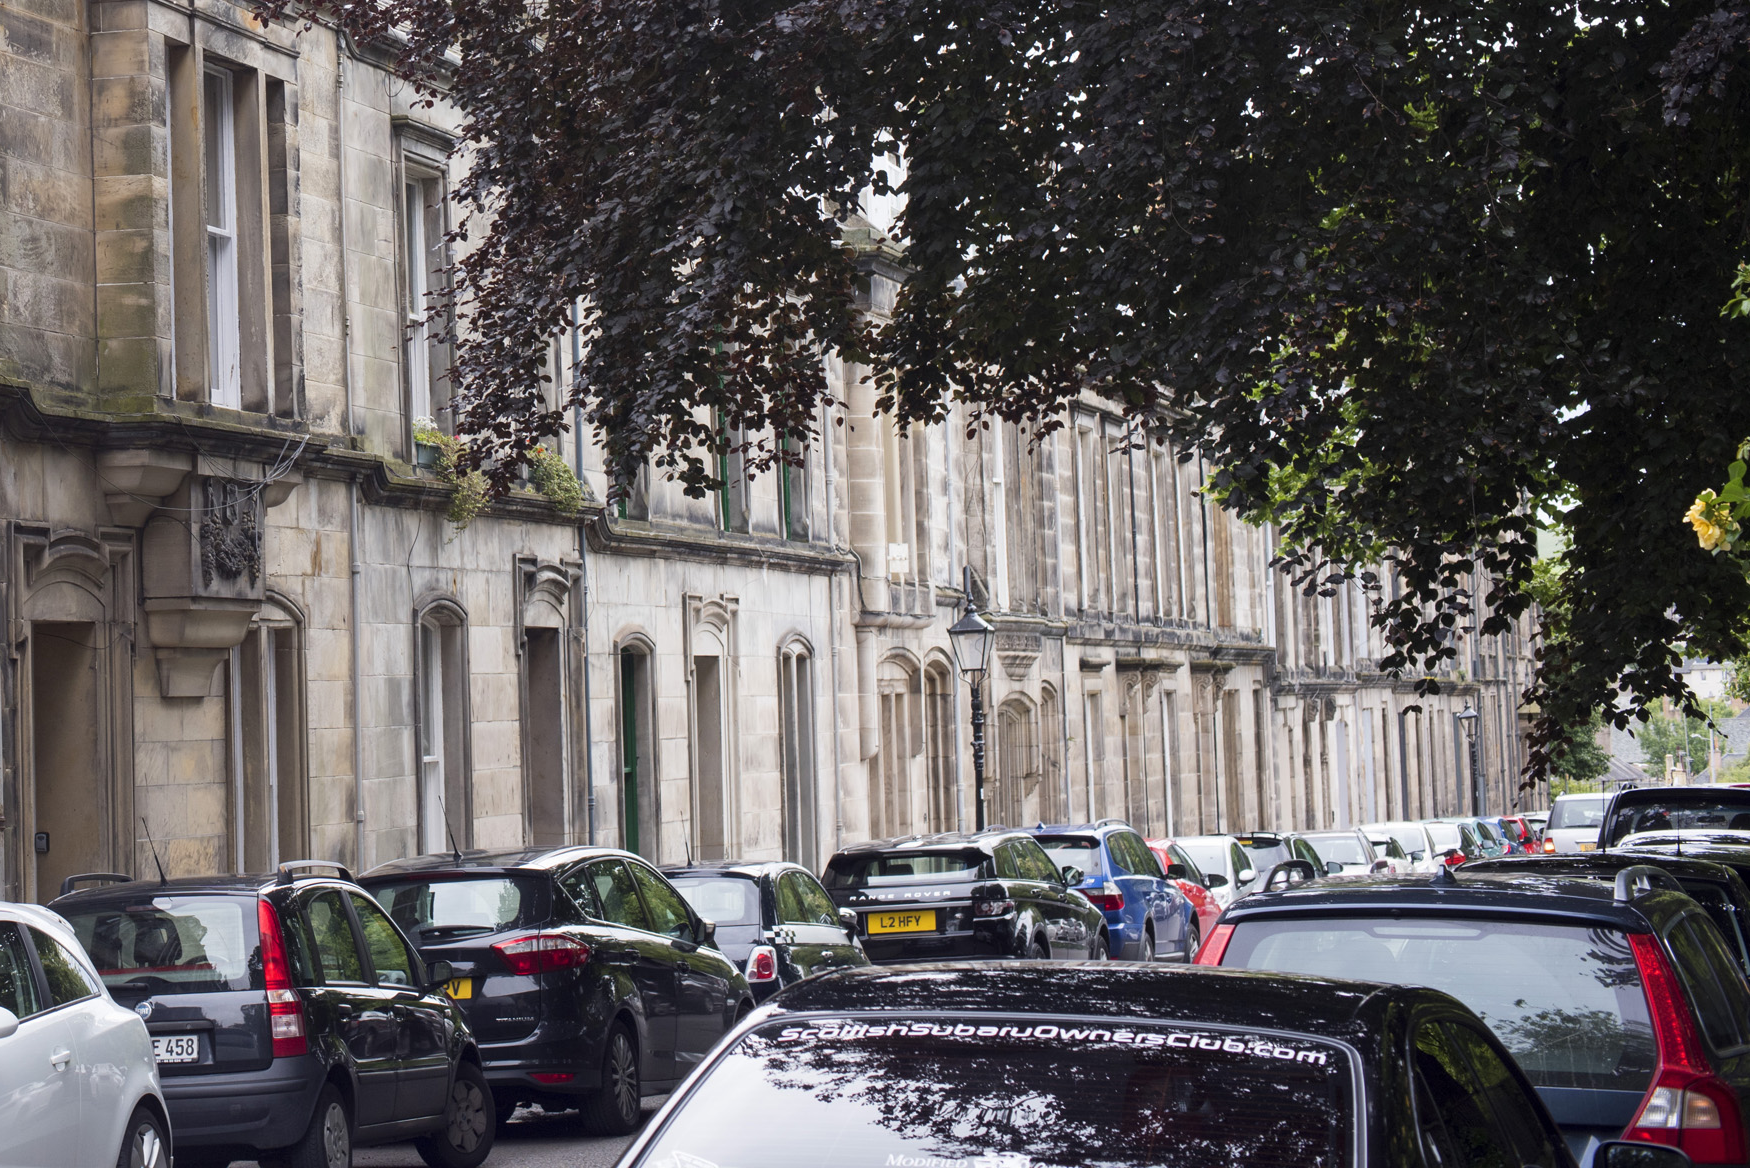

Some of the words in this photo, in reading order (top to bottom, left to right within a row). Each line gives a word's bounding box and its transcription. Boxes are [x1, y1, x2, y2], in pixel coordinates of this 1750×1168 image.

[849, 893, 895, 901] RANGE
[904, 890, 951, 898] ROVER
[880, 917, 895, 928] L2
[898, 915, 921, 927] HFY
[165, 1038, 195, 1057] 458
[777, 1023, 1327, 1065] ScottishSubaruOwnersClub.com
